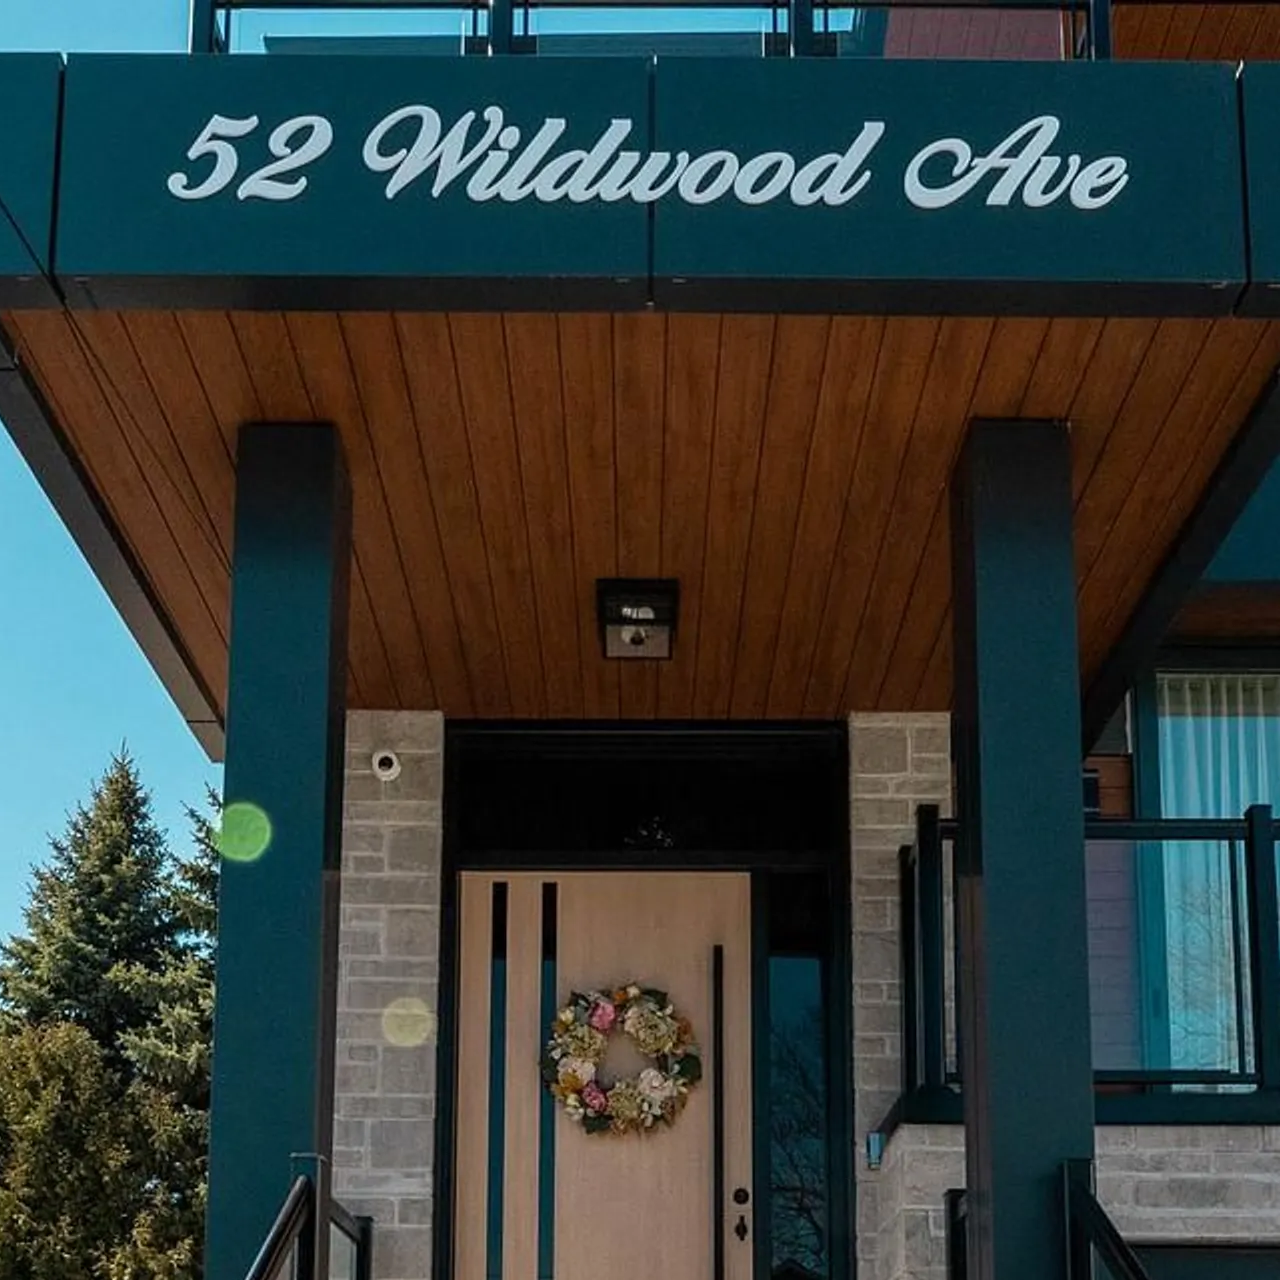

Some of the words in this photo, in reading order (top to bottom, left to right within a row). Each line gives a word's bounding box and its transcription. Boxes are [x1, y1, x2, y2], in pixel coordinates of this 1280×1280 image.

[166, 112, 334, 202] 52
[362, 104, 886, 206] Wildwood
[903, 115, 1130, 210] Ave
